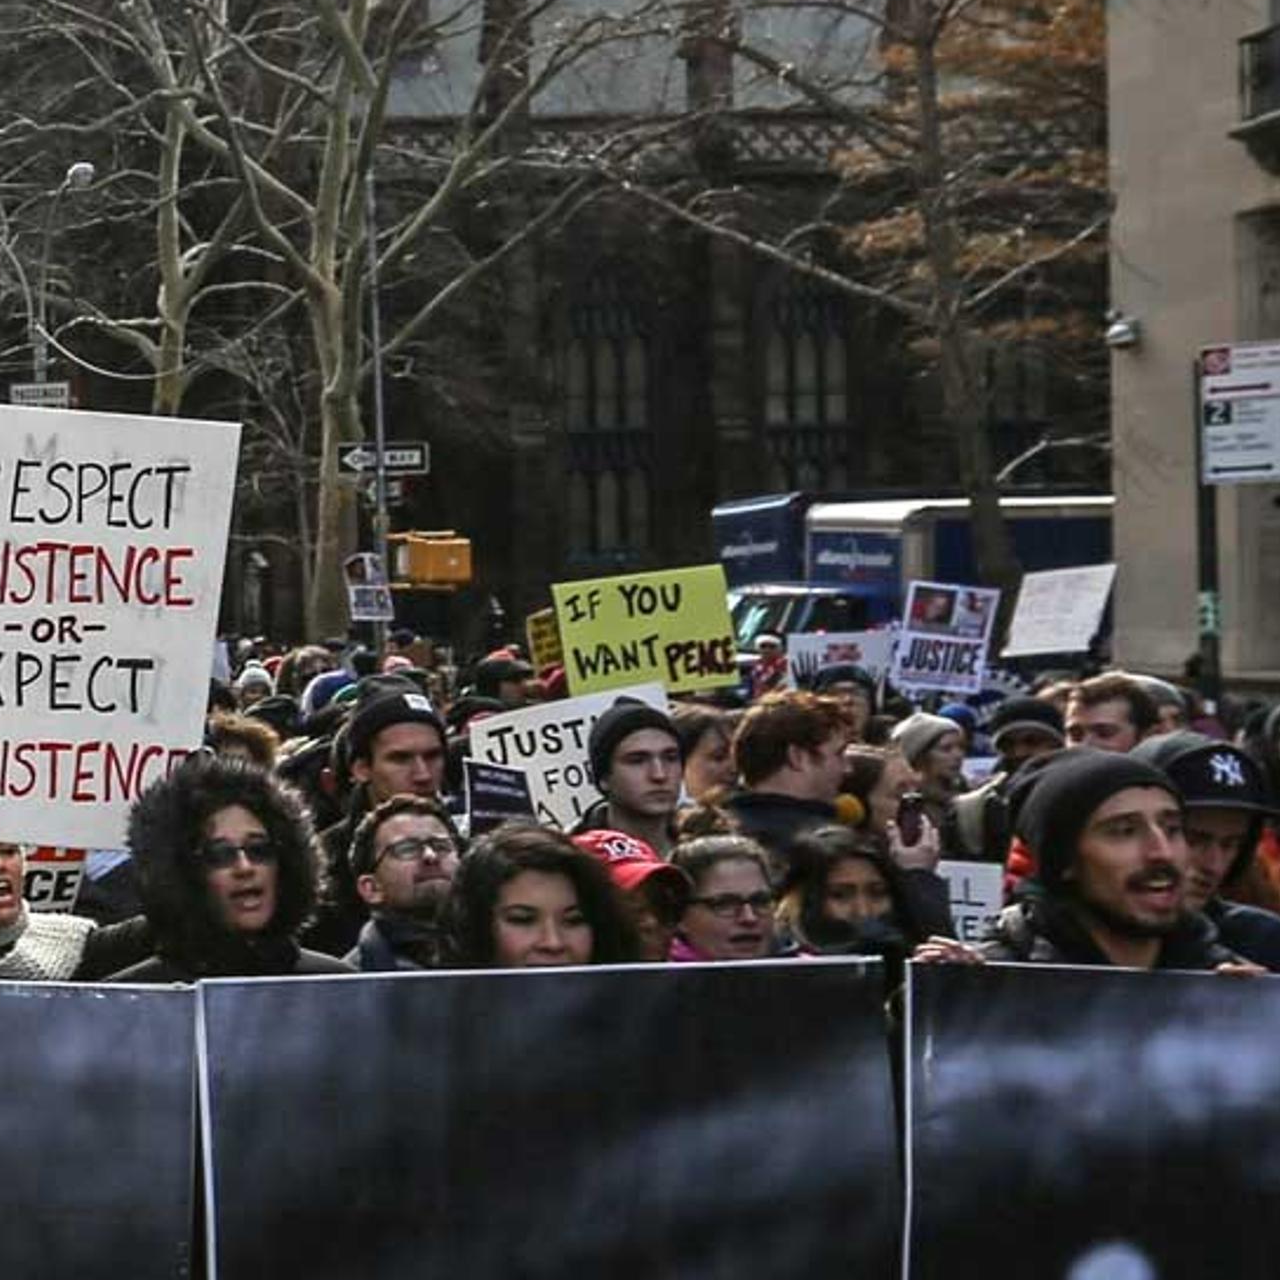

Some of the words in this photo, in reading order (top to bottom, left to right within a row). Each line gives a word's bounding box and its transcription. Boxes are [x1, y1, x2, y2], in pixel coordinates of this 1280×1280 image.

[1209, 403, 1225, 423] 2
[565, 589, 601, 622] IF
[618, 583, 682, 618] YOU
[573, 634, 659, 680] WANT
[664, 637, 737, 682] PEACE
[901, 638, 982, 676] JUSTICE
[487, 715, 597, 765] JUST
[25, 869, 80, 902] CE
